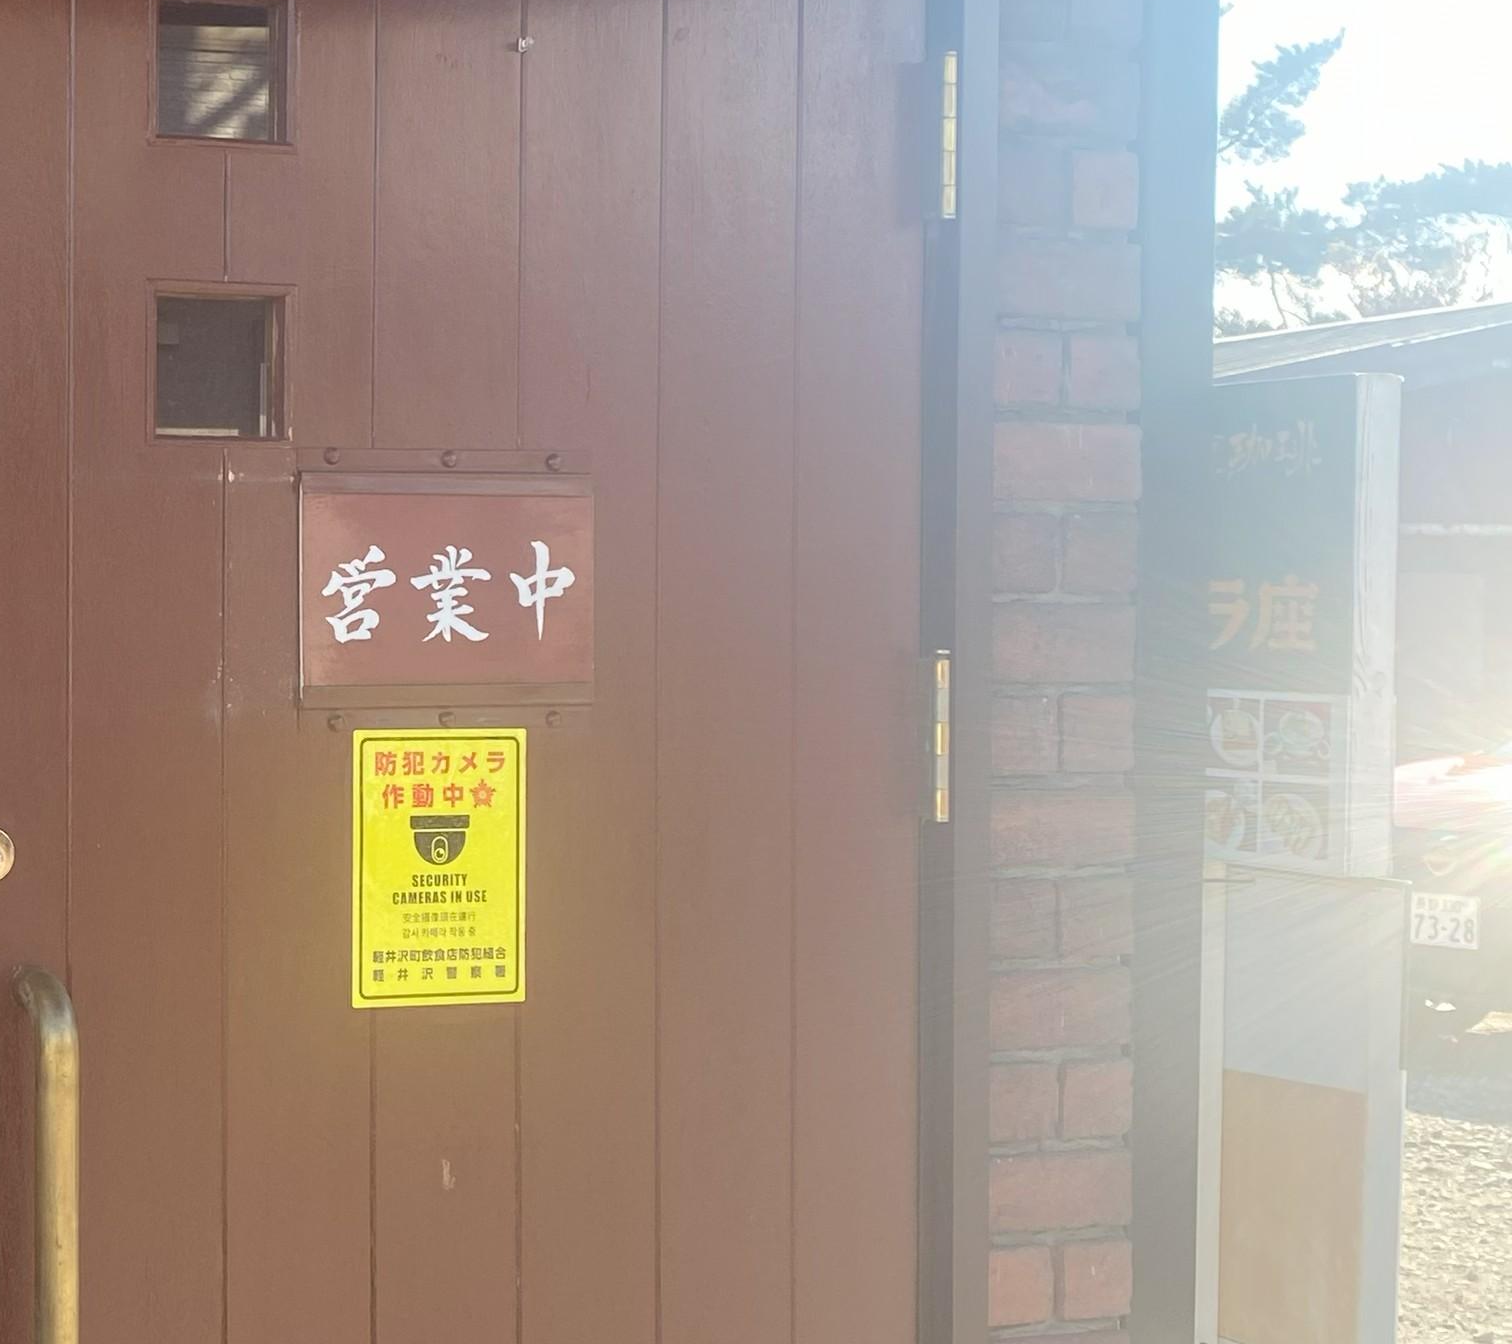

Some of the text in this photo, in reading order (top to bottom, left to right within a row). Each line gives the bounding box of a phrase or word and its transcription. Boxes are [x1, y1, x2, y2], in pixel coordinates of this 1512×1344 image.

[321, 540, 576, 643] 営業中
[374, 751, 506, 776] 防犯カメラ
[382, 783, 464, 809] 作動中
[411, 873, 468, 887] SECURITY
[392, 889, 488, 905] CAMERAS IN USE
[1413, 913, 1475, 944] 73-28
